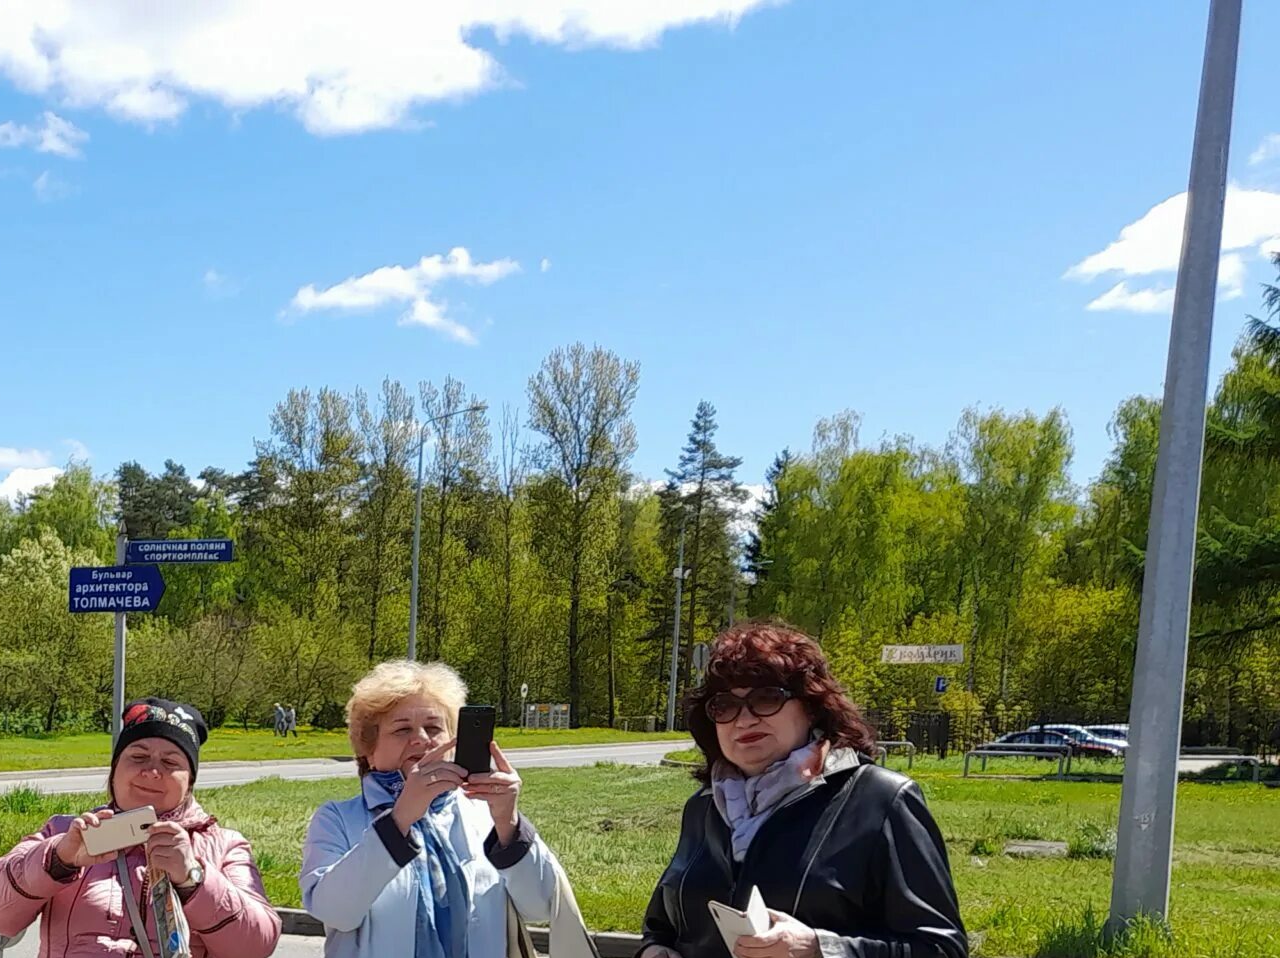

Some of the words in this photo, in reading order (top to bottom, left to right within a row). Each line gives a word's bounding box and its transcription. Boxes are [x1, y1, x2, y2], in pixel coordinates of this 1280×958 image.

[138, 543, 188, 552] СОЛНЕЧНАЯ
[190, 542, 226, 551] ПОЛЯНА
[144, 552, 220, 561] СПОРТКОМПЛЕКС
[91, 570, 133, 581] Бульвар
[75, 582, 149, 595] архитектора
[73, 596, 150, 609] ТОЛМАЧЕВА
